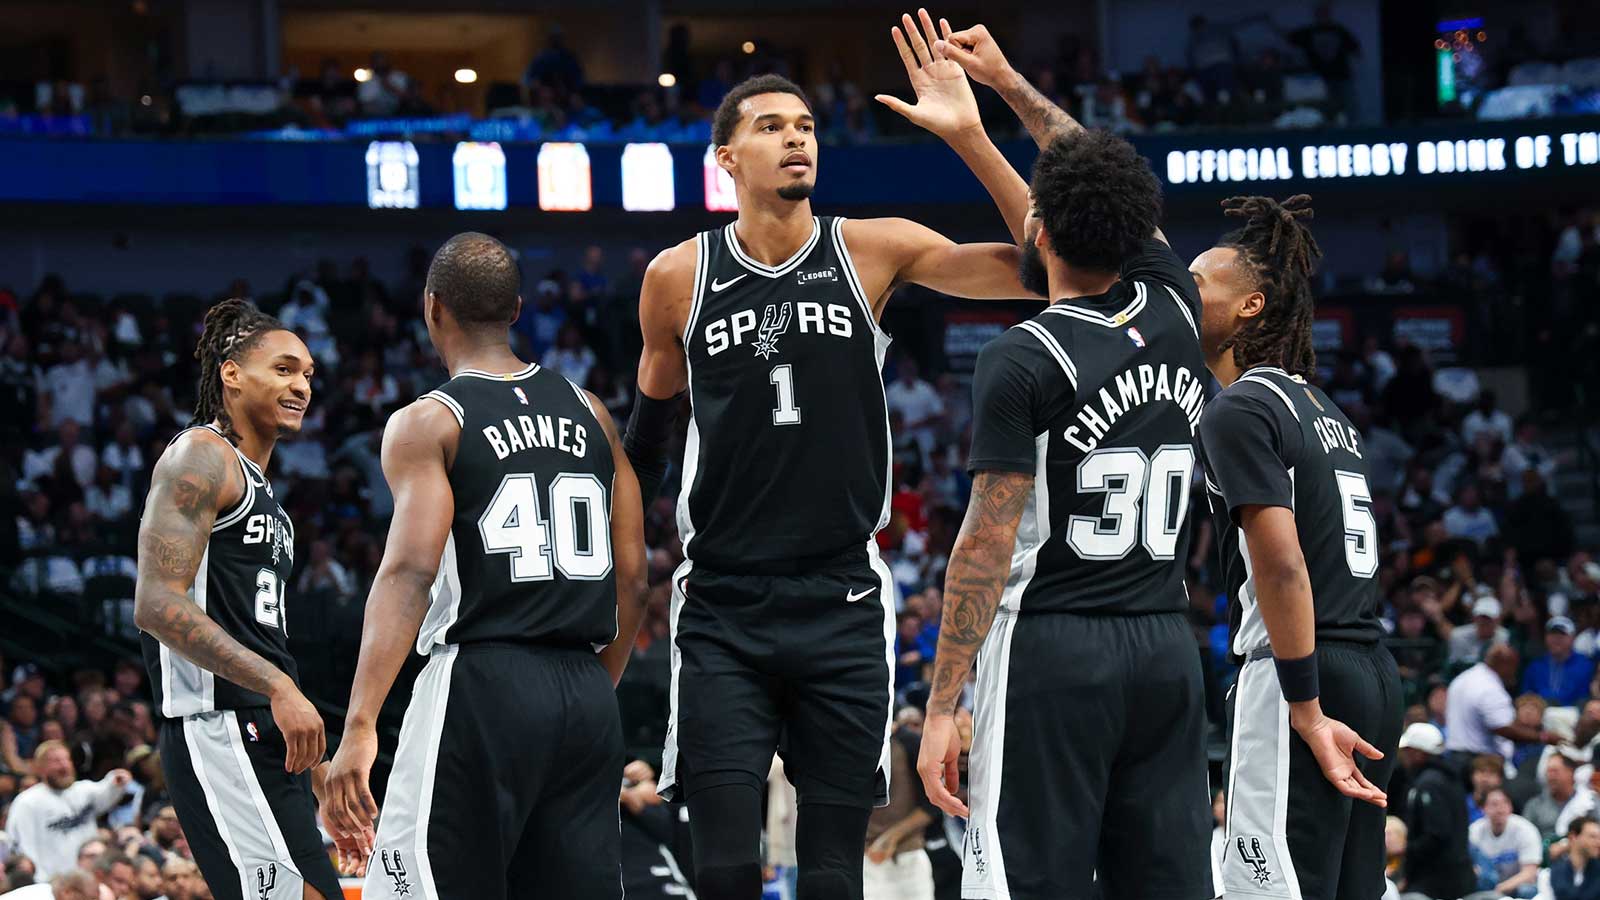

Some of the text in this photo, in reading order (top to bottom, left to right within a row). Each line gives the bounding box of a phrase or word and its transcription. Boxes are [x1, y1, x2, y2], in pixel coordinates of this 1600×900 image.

[1167, 132, 1600, 184] OFFICIAL ENERGY DRINK OF TH
[802, 270, 833, 281] LEDGER
[705, 301, 853, 361] SPURS
[769, 363, 802, 426] 1
[482, 414, 587, 460] BARNES
[1313, 416, 1363, 459] CASTLE
[477, 472, 614, 583] 40
[1065, 443, 1196, 561] 30
[1334, 468, 1379, 579] 5
[255, 567, 289, 639] 2
